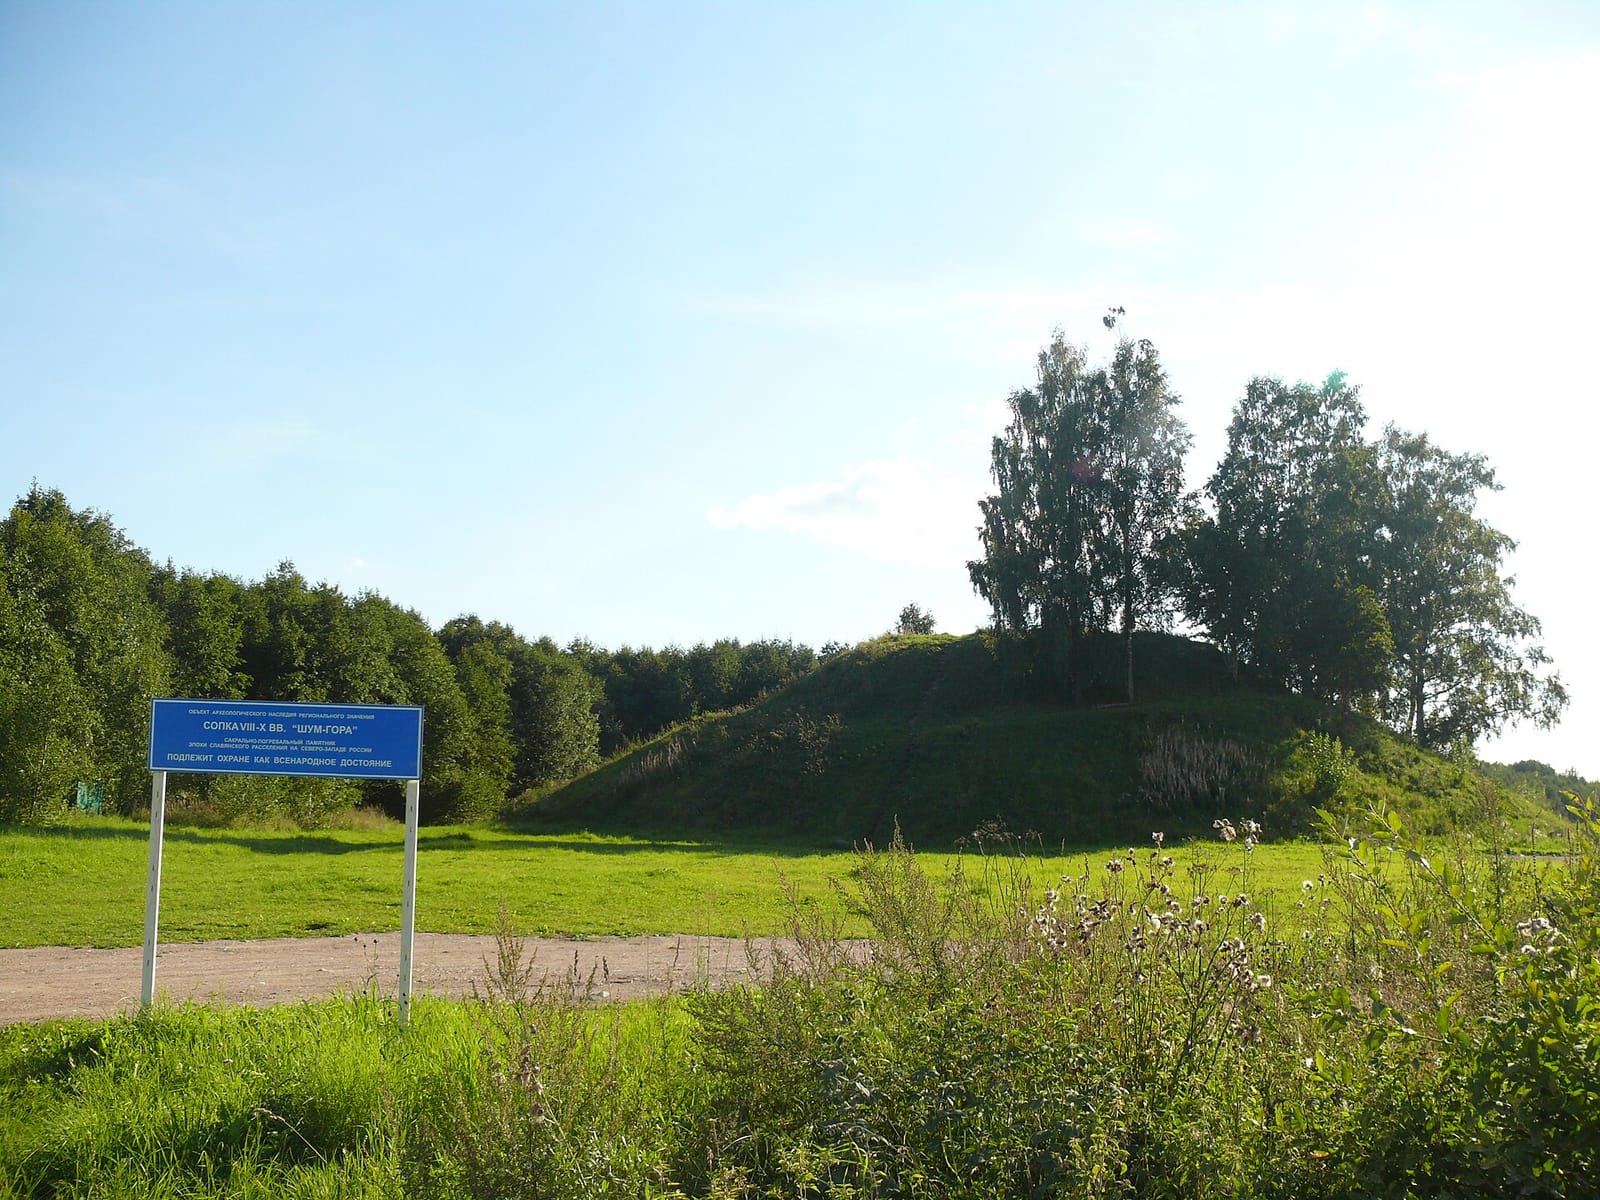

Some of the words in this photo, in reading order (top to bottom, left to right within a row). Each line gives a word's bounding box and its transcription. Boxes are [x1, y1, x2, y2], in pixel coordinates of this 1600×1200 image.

[203, 721, 239, 731] СОПКА
[269, 723, 287, 733] ВВ.
[167, 753, 214, 762] ПОДЛЕЖИТ
[217, 755, 250, 763] ОХРАНЕ
[254, 756, 270, 764] КАК
[273, 756, 337, 766] ВСЕНАРОДНОЕ
[340, 758, 393, 768] ДОСТОЯНИЕ
